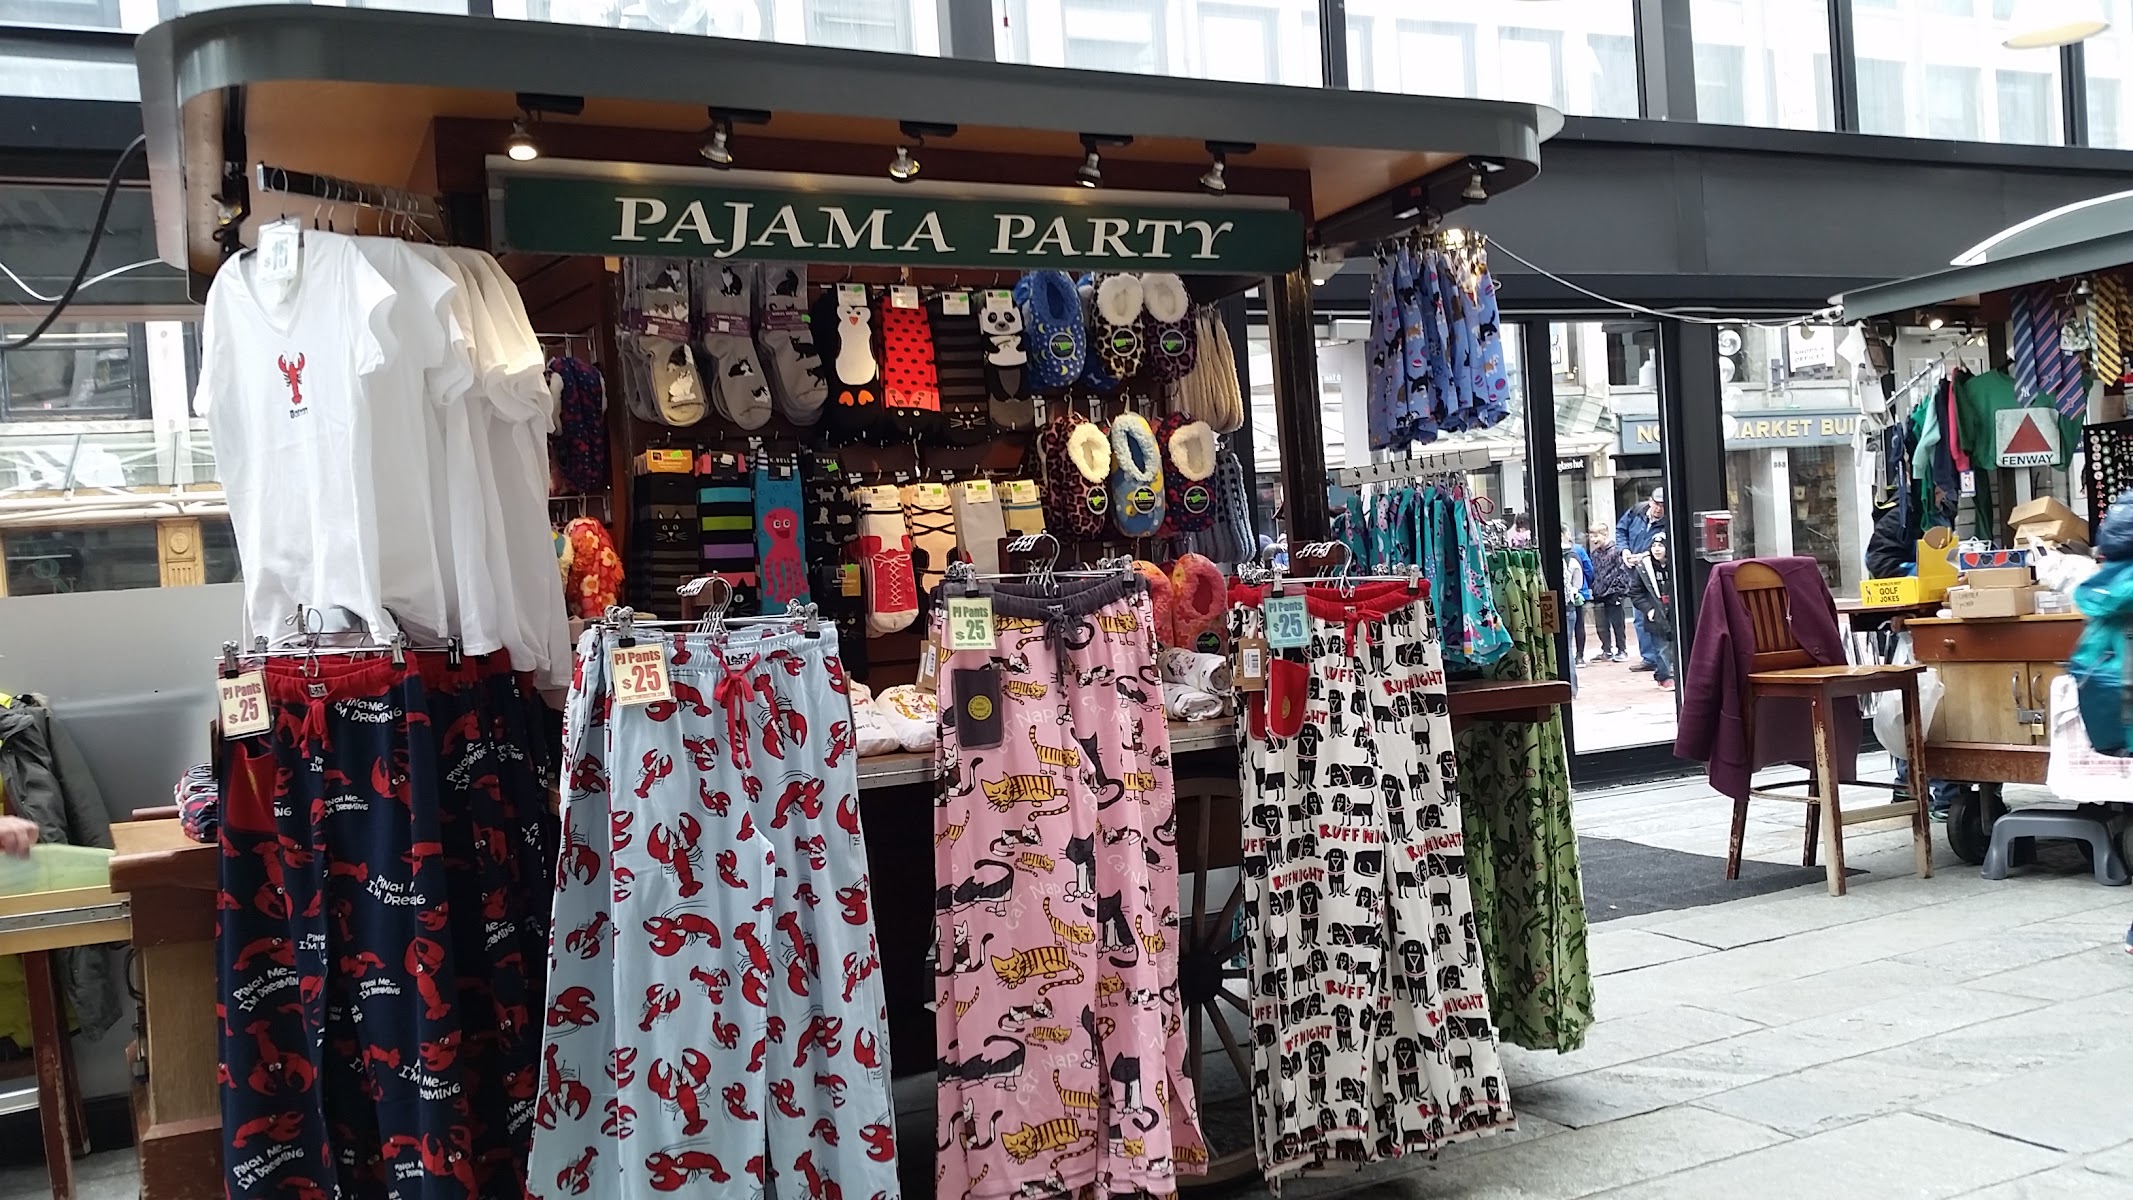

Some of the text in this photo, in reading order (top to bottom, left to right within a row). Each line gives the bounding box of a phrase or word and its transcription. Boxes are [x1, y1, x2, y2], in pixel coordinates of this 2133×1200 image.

[610, 196, 1234, 260] PAJAMA PARTY
[2002, 454, 2053, 466] FENWAY
[1879, 587, 1898, 595] GOLF
[1880, 595, 1900, 603] JOKES
[953, 606, 989, 618] PJ Pants
[1268, 601, 1303, 613] PJ Pants
[955, 620, 986, 640] $25
[1273, 613, 1303, 638] $25
[614, 650, 661, 666] PJ Pants
[622, 664, 662, 693] $25
[223, 683, 262, 700] PJ Pants
[228, 697, 260, 725] $25
[1319, 824, 1359, 842] RUFF
[1325, 980, 1366, 999] RUFF
